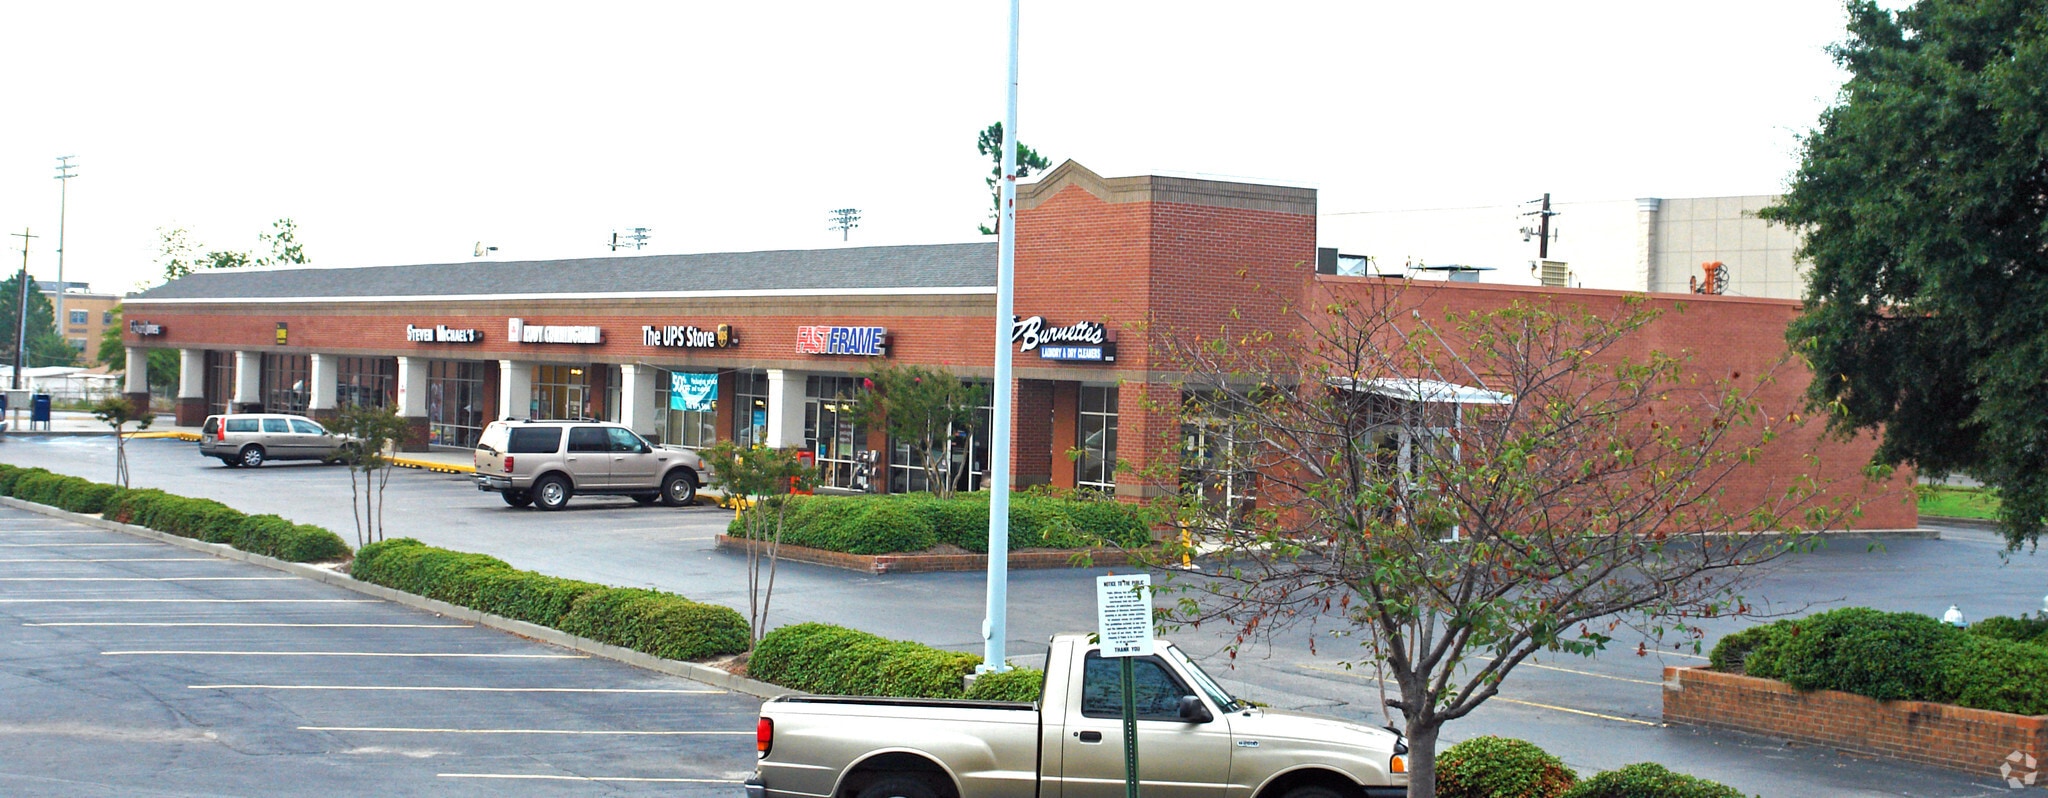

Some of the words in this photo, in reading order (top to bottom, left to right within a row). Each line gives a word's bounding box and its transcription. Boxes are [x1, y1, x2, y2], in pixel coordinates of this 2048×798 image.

[641, 325, 661, 346] The
[663, 325, 684, 347] UPS
[686, 325, 715, 347] Store
[1012, 315, 1104, 352] Burnette's
